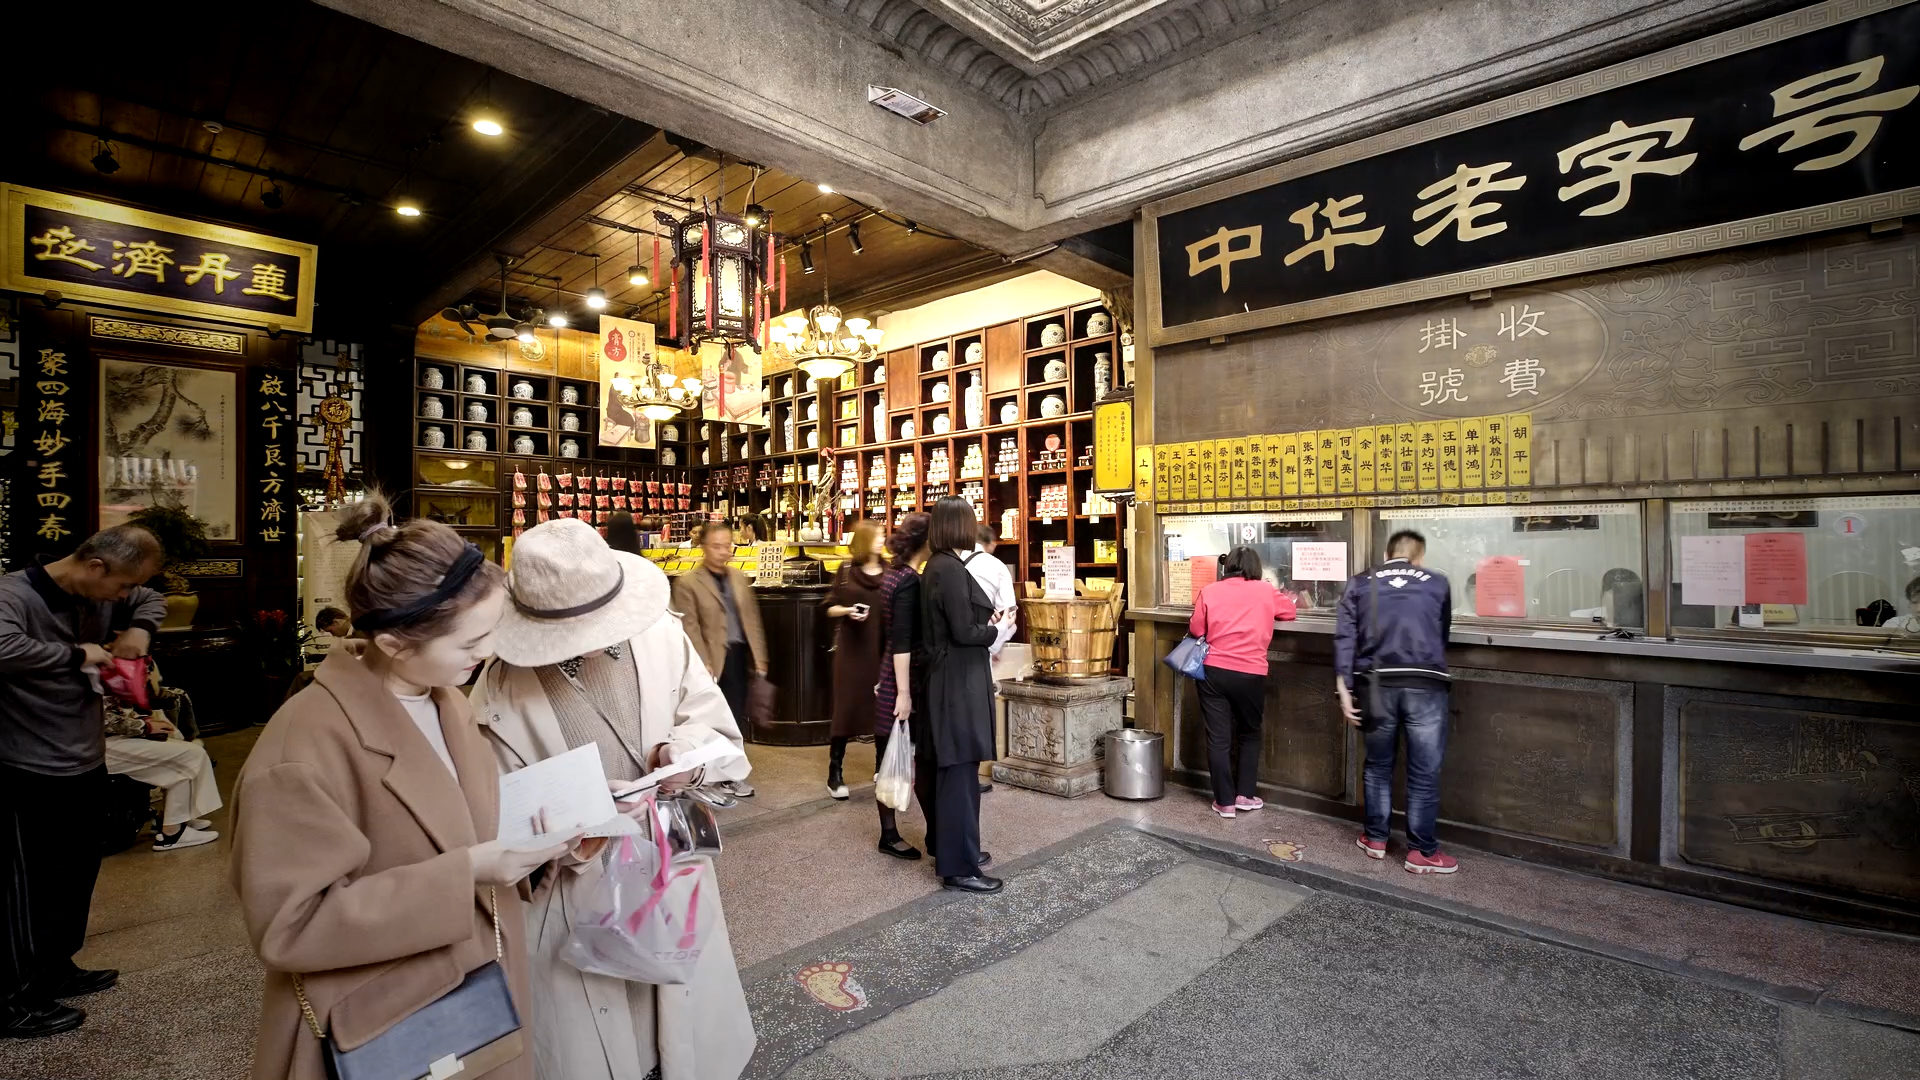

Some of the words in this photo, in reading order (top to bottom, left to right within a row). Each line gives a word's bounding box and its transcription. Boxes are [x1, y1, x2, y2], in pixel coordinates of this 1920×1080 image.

[1184, 54, 1920, 294] 中华老字号
[1418, 317, 1469, 407] 掛號
[1496, 303, 1551, 398] 收費
[1267, 444, 1279, 480] 叶秀珠
[1303, 441, 1315, 478] 张秀萍
[1321, 438, 1334, 470] 唐旭
[1340, 436, 1353, 474] 何慧英
[1360, 438, 1373, 471] 余兴
[1400, 432, 1414, 472] 沈壮雷
[1421, 432, 1435, 473] 李灼华
[1442, 430, 1458, 472] 汪明德
[1465, 428, 1480, 470] 单祥鸿
[1489, 423, 1503, 481] 甲状腺门诊
[1513, 426, 1528, 462] 胡平
[1139, 458, 1149, 488] 上午
[1187, 448, 1198, 481] 王金生
[1245, 528, 1253, 538] 3
[1843, 519, 1855, 534] 1
